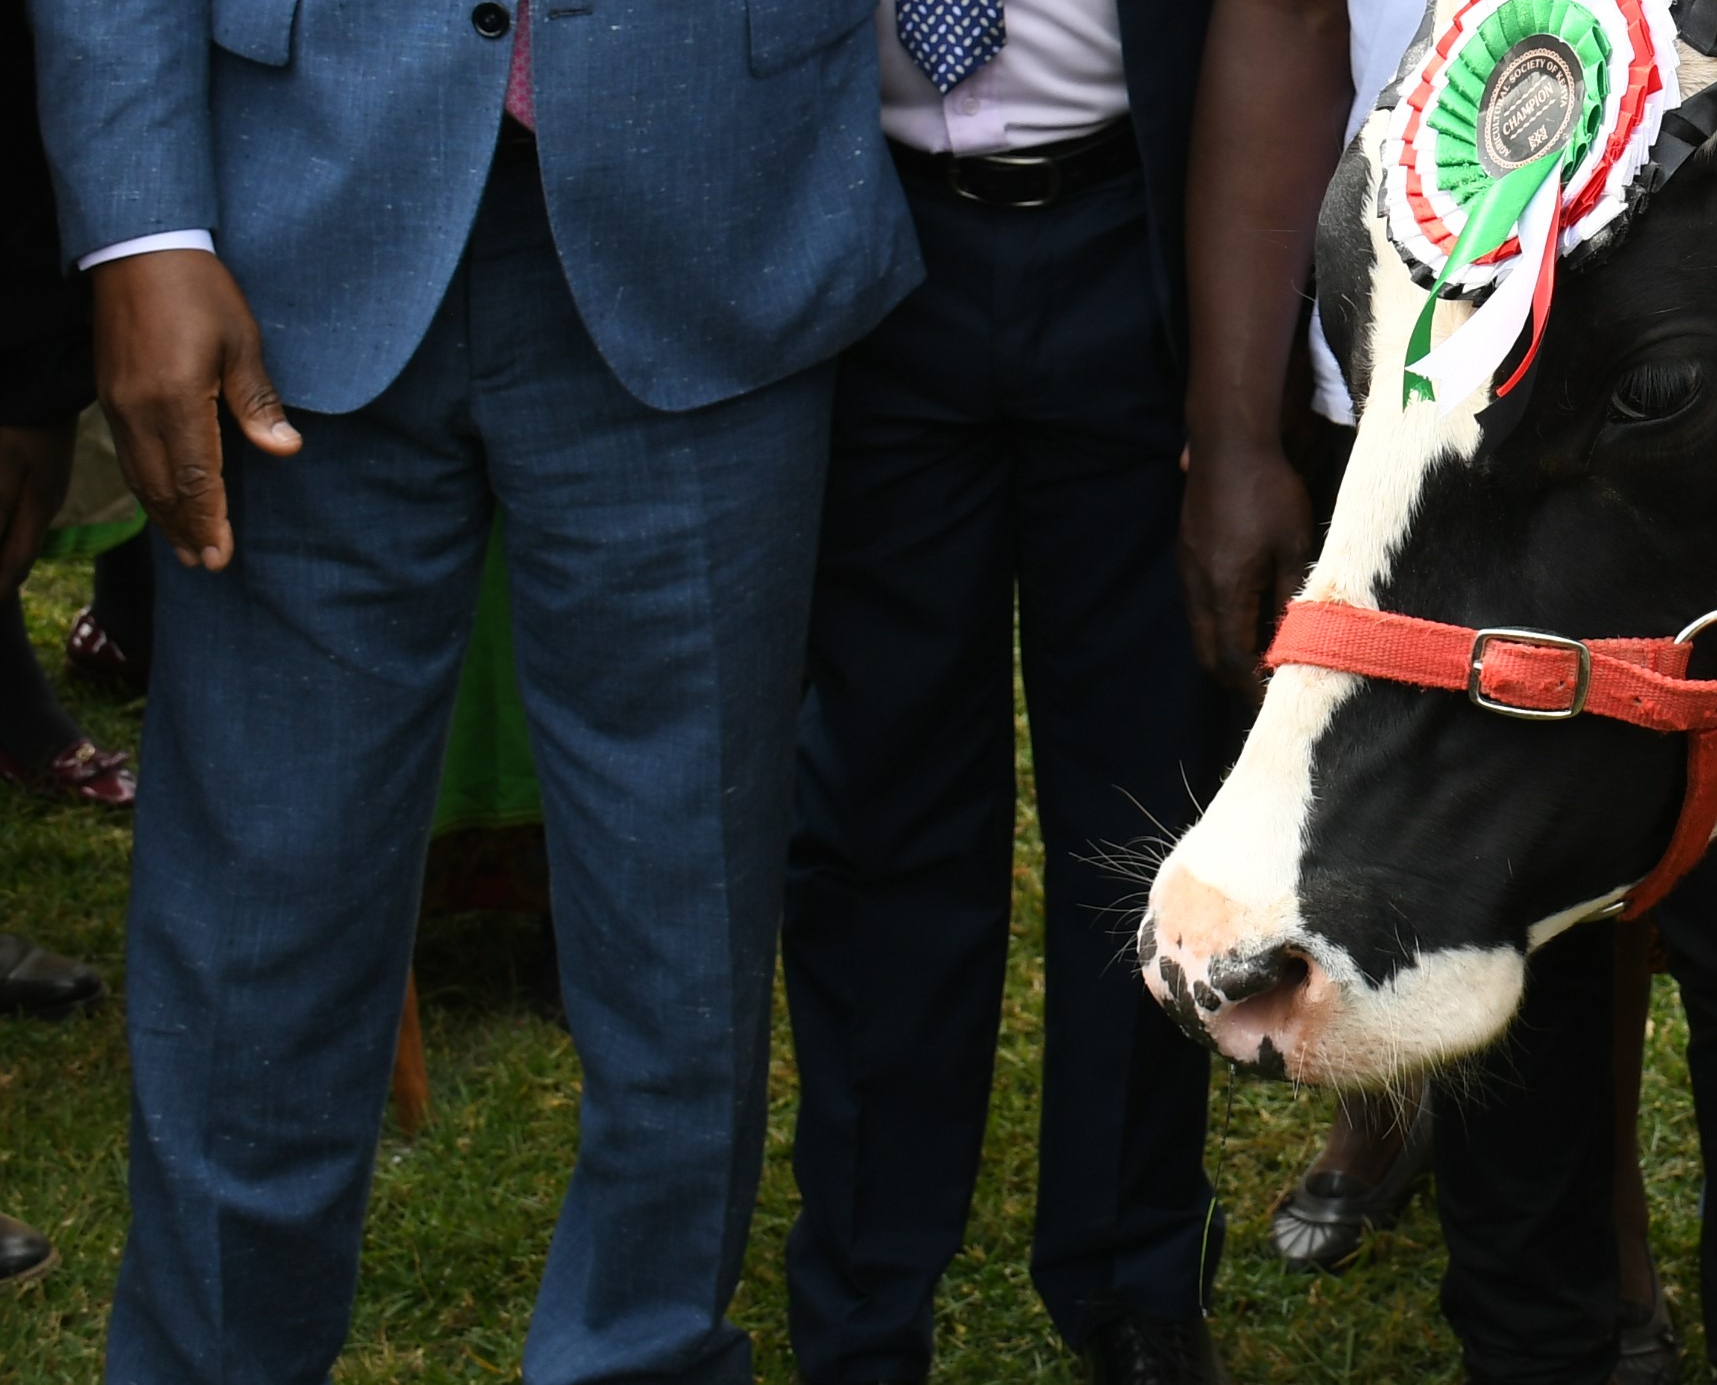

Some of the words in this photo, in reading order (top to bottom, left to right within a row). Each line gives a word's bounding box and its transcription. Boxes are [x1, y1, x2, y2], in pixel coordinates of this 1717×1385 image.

[1492, 83, 1512, 157] AGRICULTURAL
[1510, 59, 1546, 83] SOCIETY
[1546, 61, 1558, 73] OF
[1555, 69, 1569, 108] KENYA
[1502, 83, 1554, 135] CHAMPION
